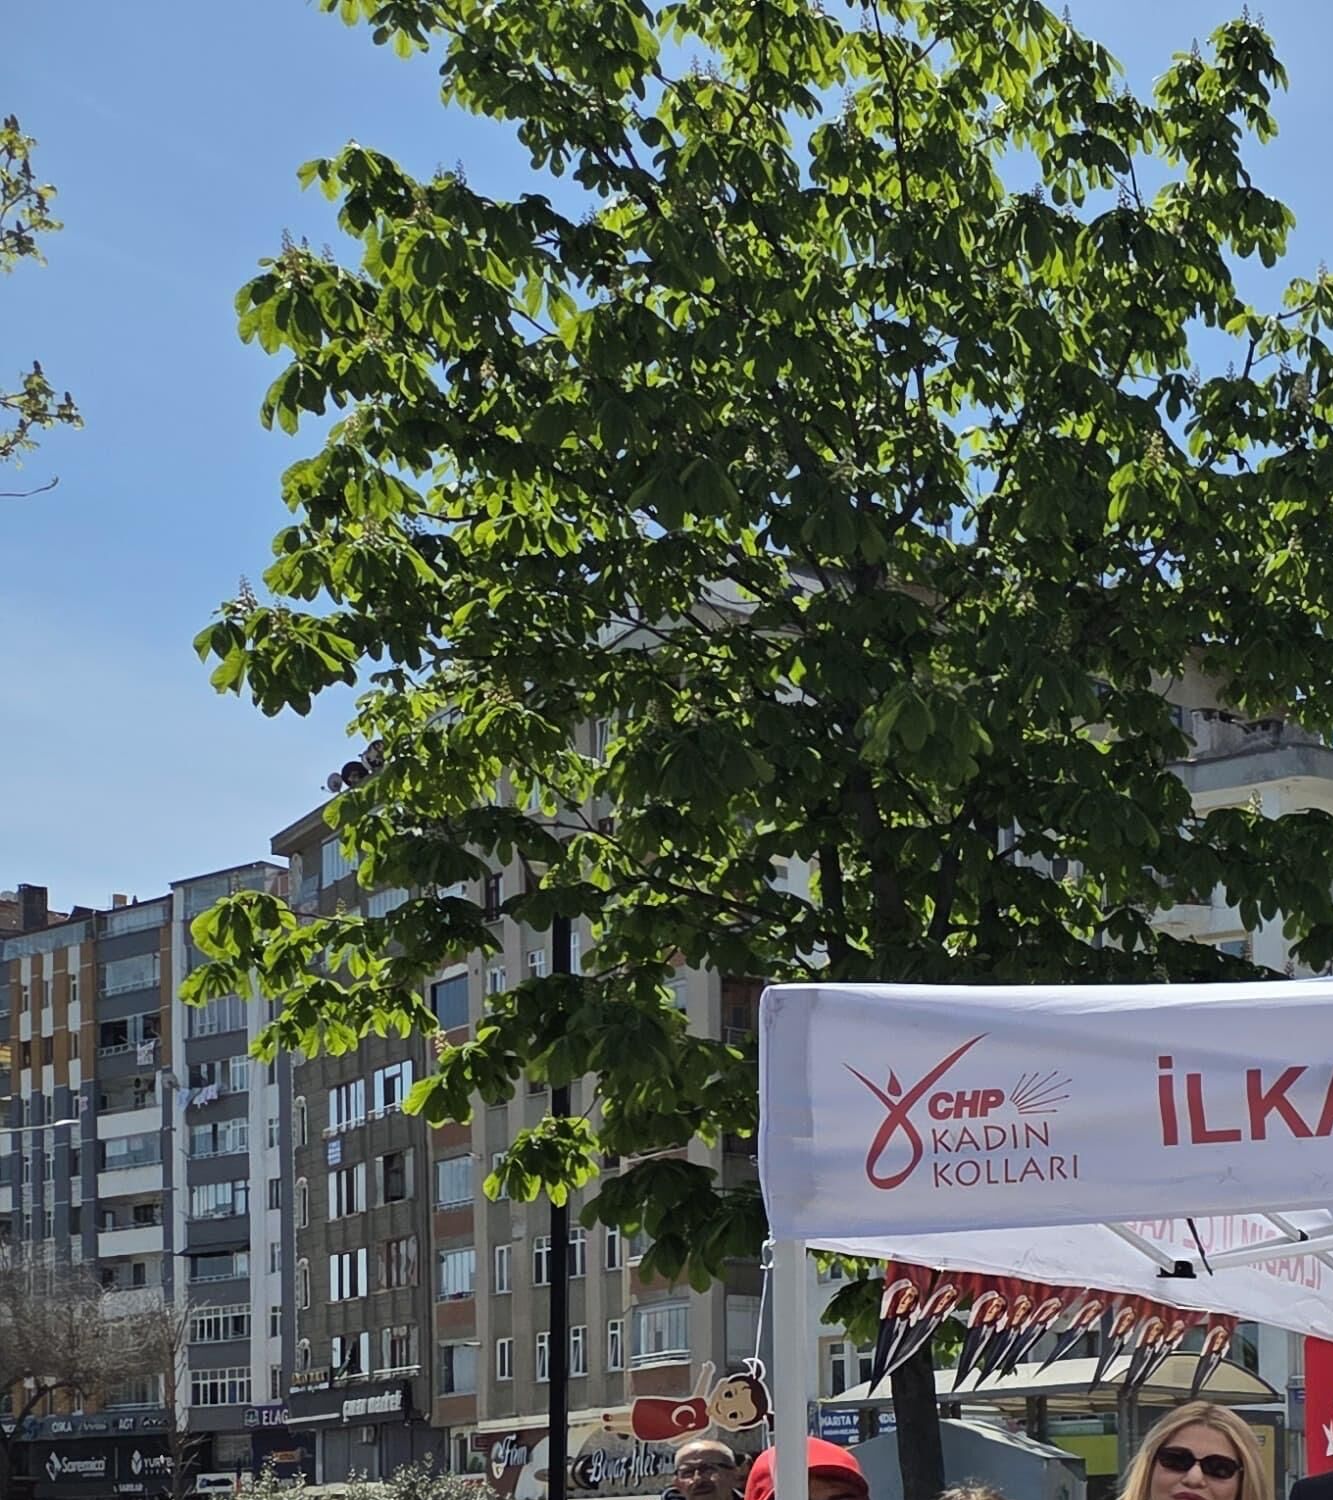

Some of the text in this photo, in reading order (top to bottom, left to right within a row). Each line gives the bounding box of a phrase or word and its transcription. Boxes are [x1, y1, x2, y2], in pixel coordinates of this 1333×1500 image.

[928, 1089, 1005, 1120] CHP
[931, 1120, 1051, 1155] KADIN
[932, 1153, 1080, 1189] KOLLARI
